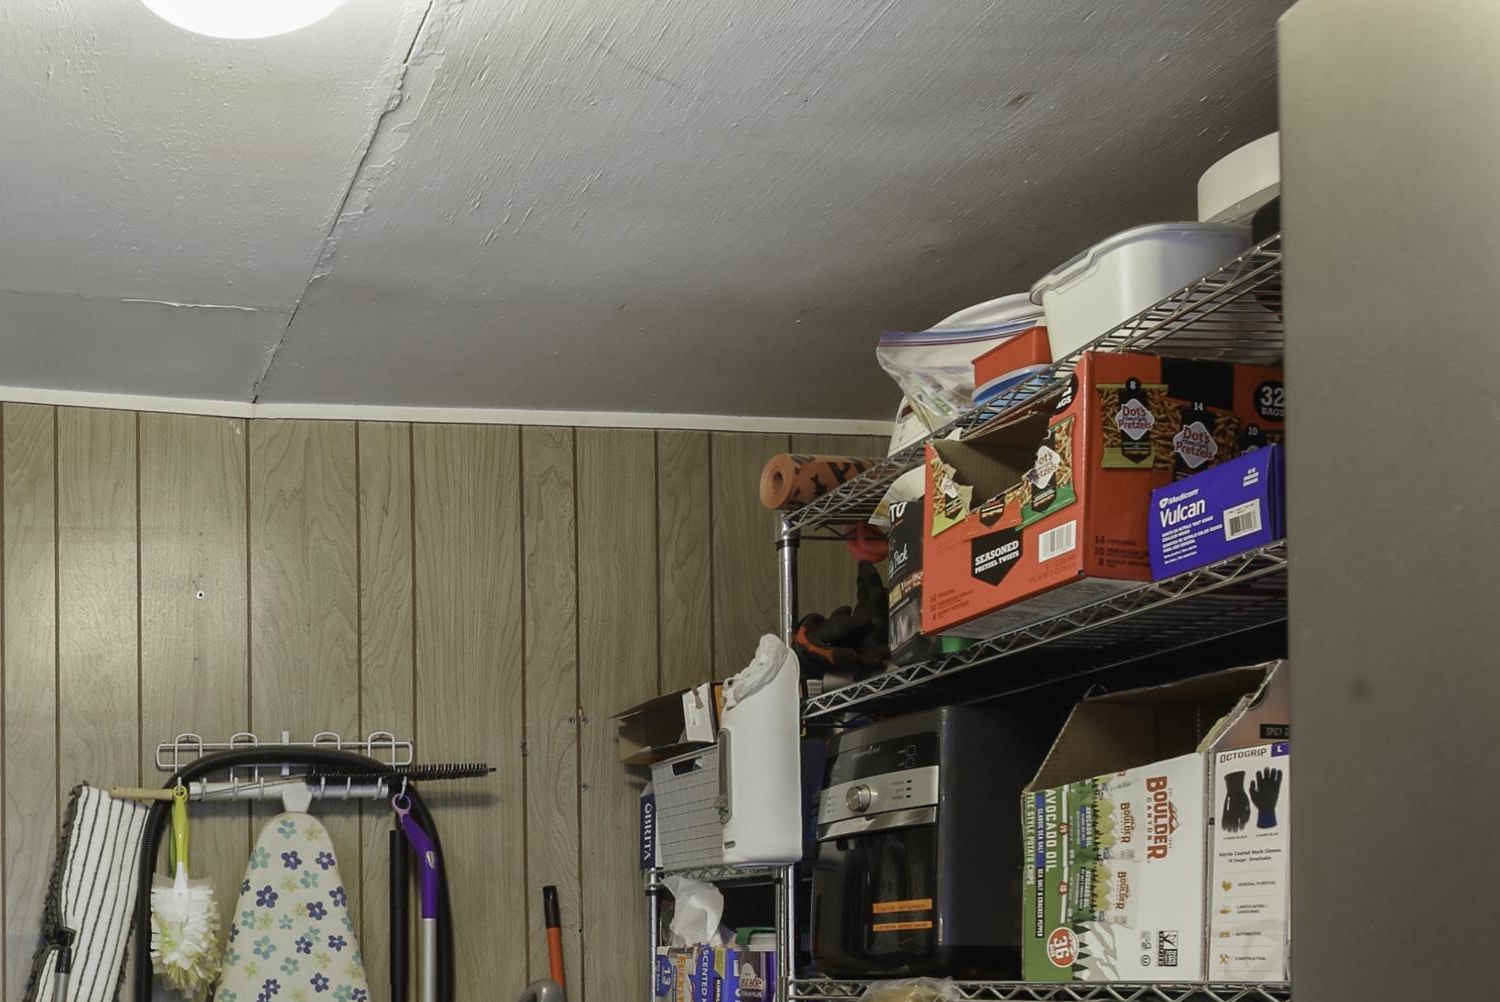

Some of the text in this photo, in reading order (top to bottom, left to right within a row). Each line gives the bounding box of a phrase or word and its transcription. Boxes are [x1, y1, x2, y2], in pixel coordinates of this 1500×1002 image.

[1130, 381, 1137, 390] 8
[1194, 402, 1204, 411] 14
[1260, 386, 1284, 407] 32
[1123, 406, 1147, 417] Dot's
[1118, 419, 1152, 430] Pretzels
[1184, 426, 1210, 444] Dot's
[1176, 441, 1213, 460] Pretzels
[1160, 500, 1206, 528] Vulcan
[975, 540, 1019, 566] SEASONED
[975, 550, 1020, 574] PRETZEL TWISTS
[1220, 748, 1267, 763] OCTOGRIP
[1277, 745, 1283, 753] L
[1120, 802, 1132, 844] BOULDER
[1146, 775, 1168, 859] BOULDER
[643, 813, 653, 861] BRITA
[1045, 789, 1057, 872] AVOCADO OIL
[1115, 871, 1128, 910] BOULDER
[1053, 936, 1067, 960] 36
[663, 967, 671, 986] 13
